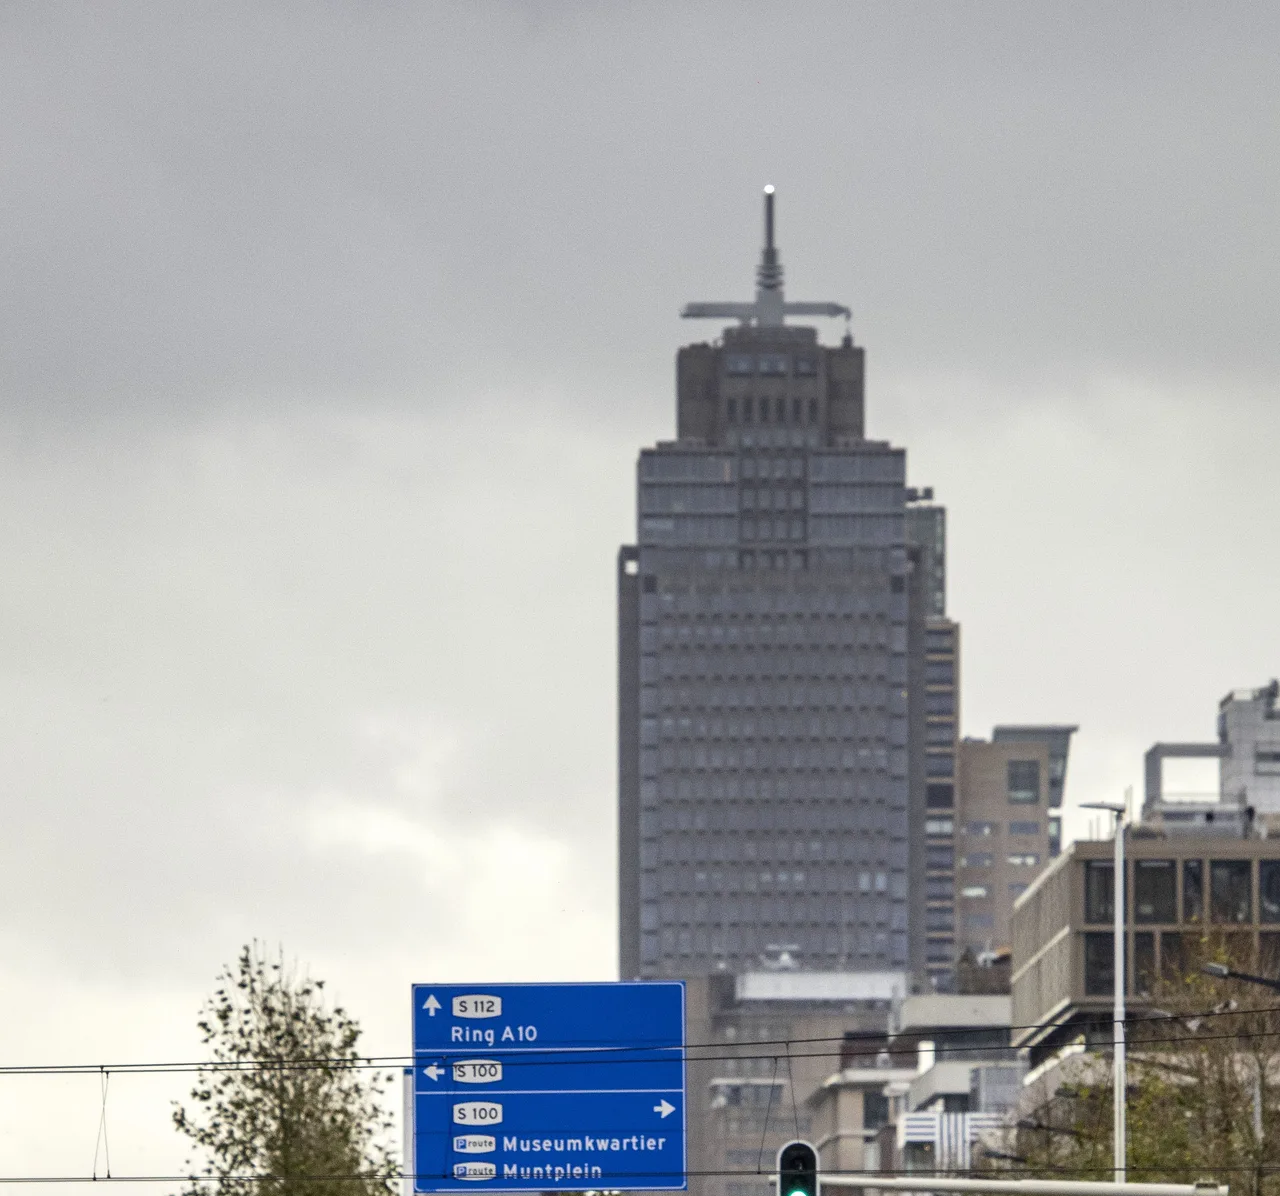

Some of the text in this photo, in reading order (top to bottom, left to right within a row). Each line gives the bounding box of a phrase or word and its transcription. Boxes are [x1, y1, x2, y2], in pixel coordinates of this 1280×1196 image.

[458, 1000, 495, 1014] S 112
[451, 1026, 538, 1046] Ring A10
[457, 1065, 498, 1078] S 100
[458, 1108, 498, 1120] S 100
[468, 1140, 494, 1149] route
[503, 1136, 666, 1152] Museumkwartier
[468, 1166, 494, 1176] route
[503, 1164, 602, 1181] Muntplein
